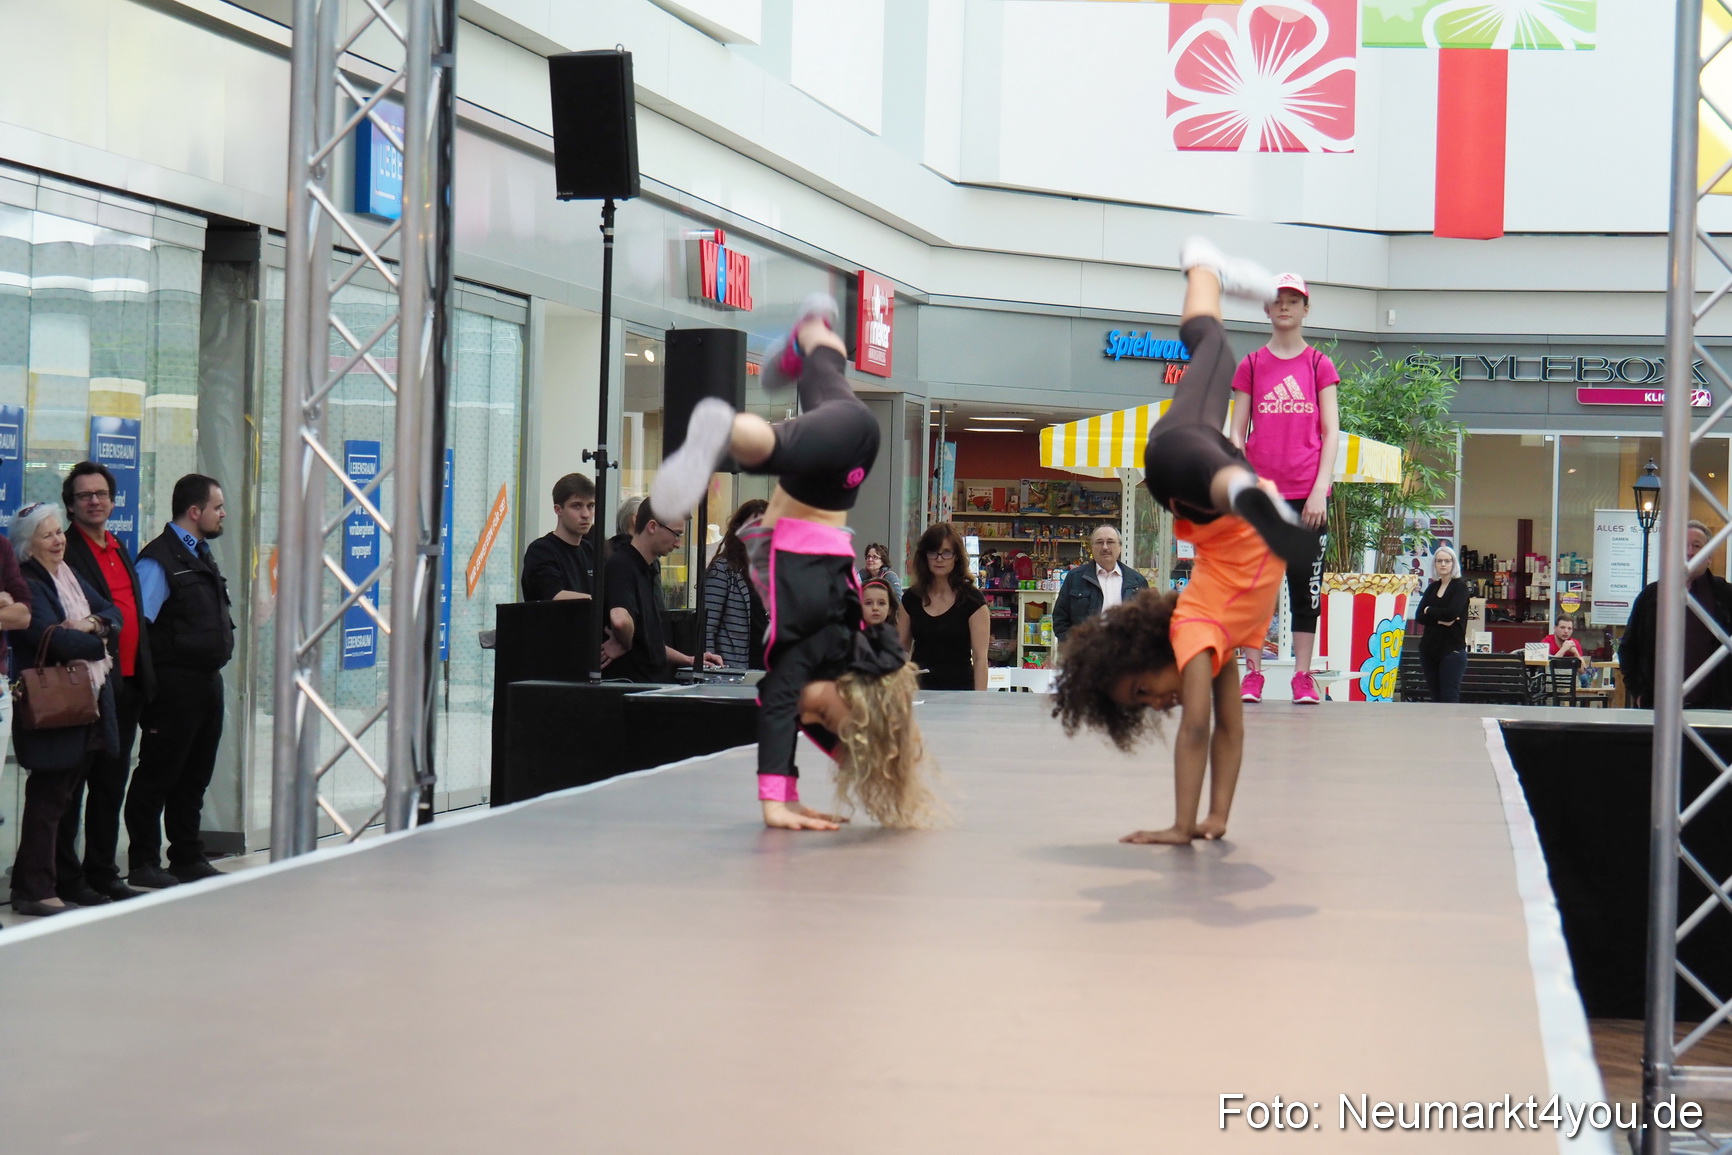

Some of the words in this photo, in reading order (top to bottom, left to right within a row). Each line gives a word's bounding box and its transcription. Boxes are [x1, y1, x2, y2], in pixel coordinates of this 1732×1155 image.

[699, 229, 752, 312] WÖHRL
[1257, 399, 1314, 413] adidas
[99, 443, 135, 459] LEBENSRAUM
[349, 462, 376, 475] LEBENSRAUM
[183, 534, 196, 547] SD
[346, 633, 372, 649] LEBENSRAUM
